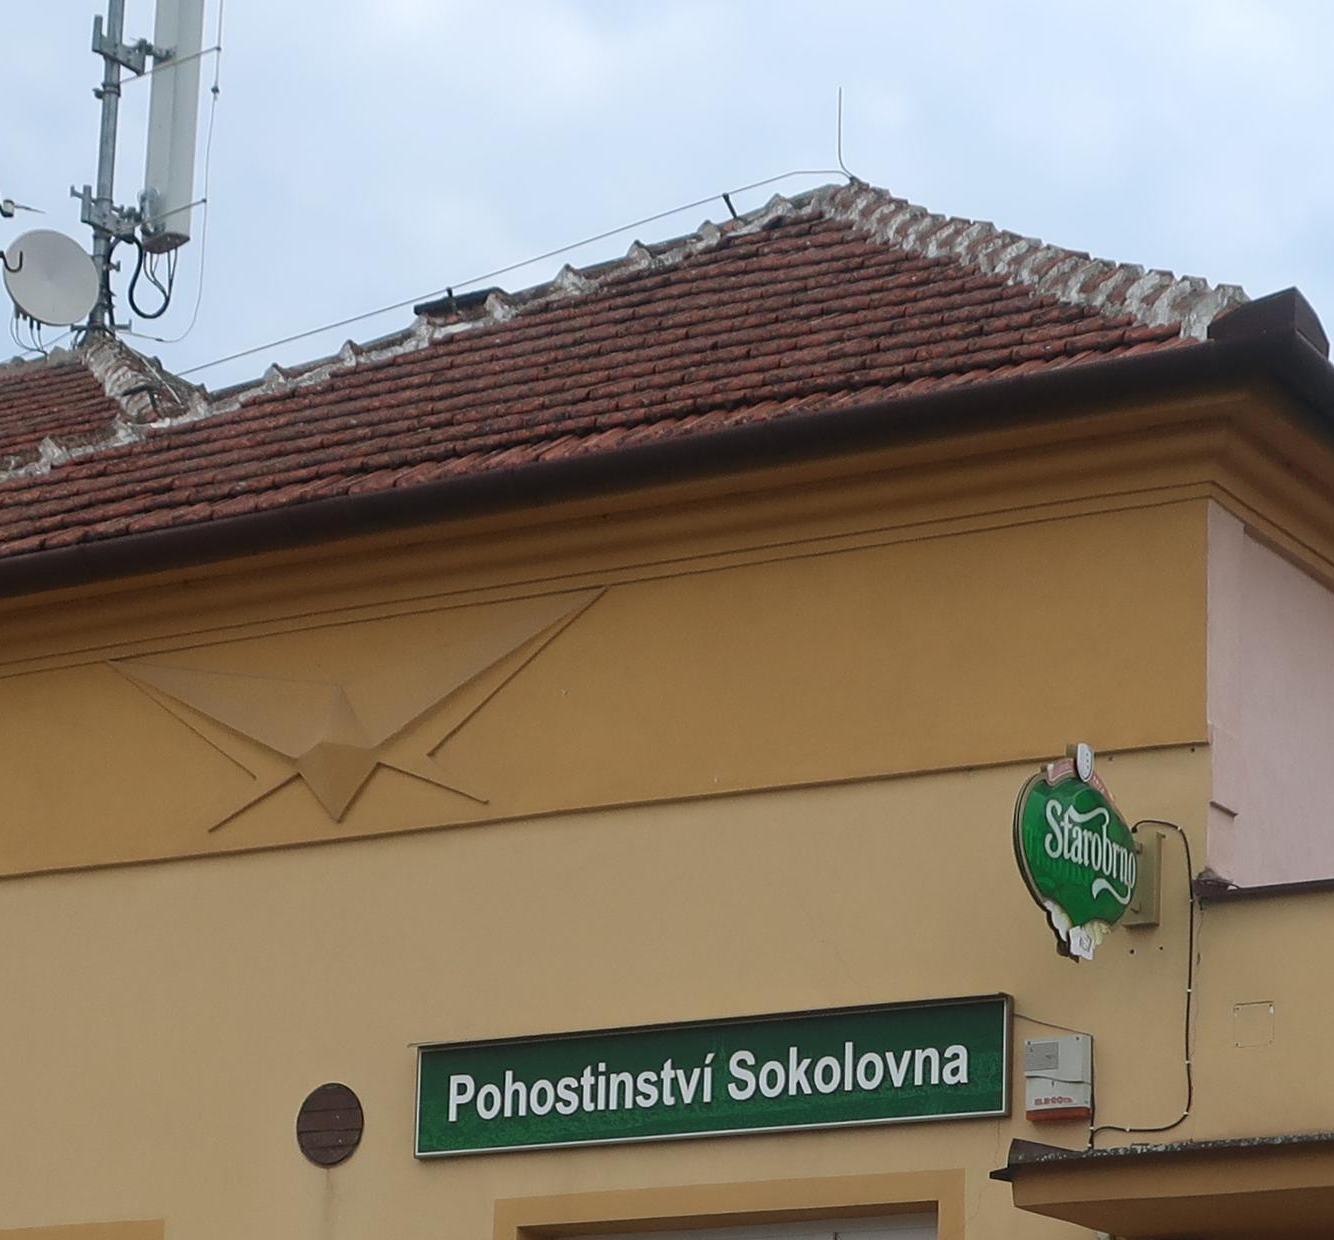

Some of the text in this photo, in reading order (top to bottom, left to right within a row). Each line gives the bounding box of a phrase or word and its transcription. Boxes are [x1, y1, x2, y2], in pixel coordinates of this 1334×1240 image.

[1044, 799, 1136, 905] Starobrno
[447, 1041, 969, 1123] Pohostinství Sokolovna
